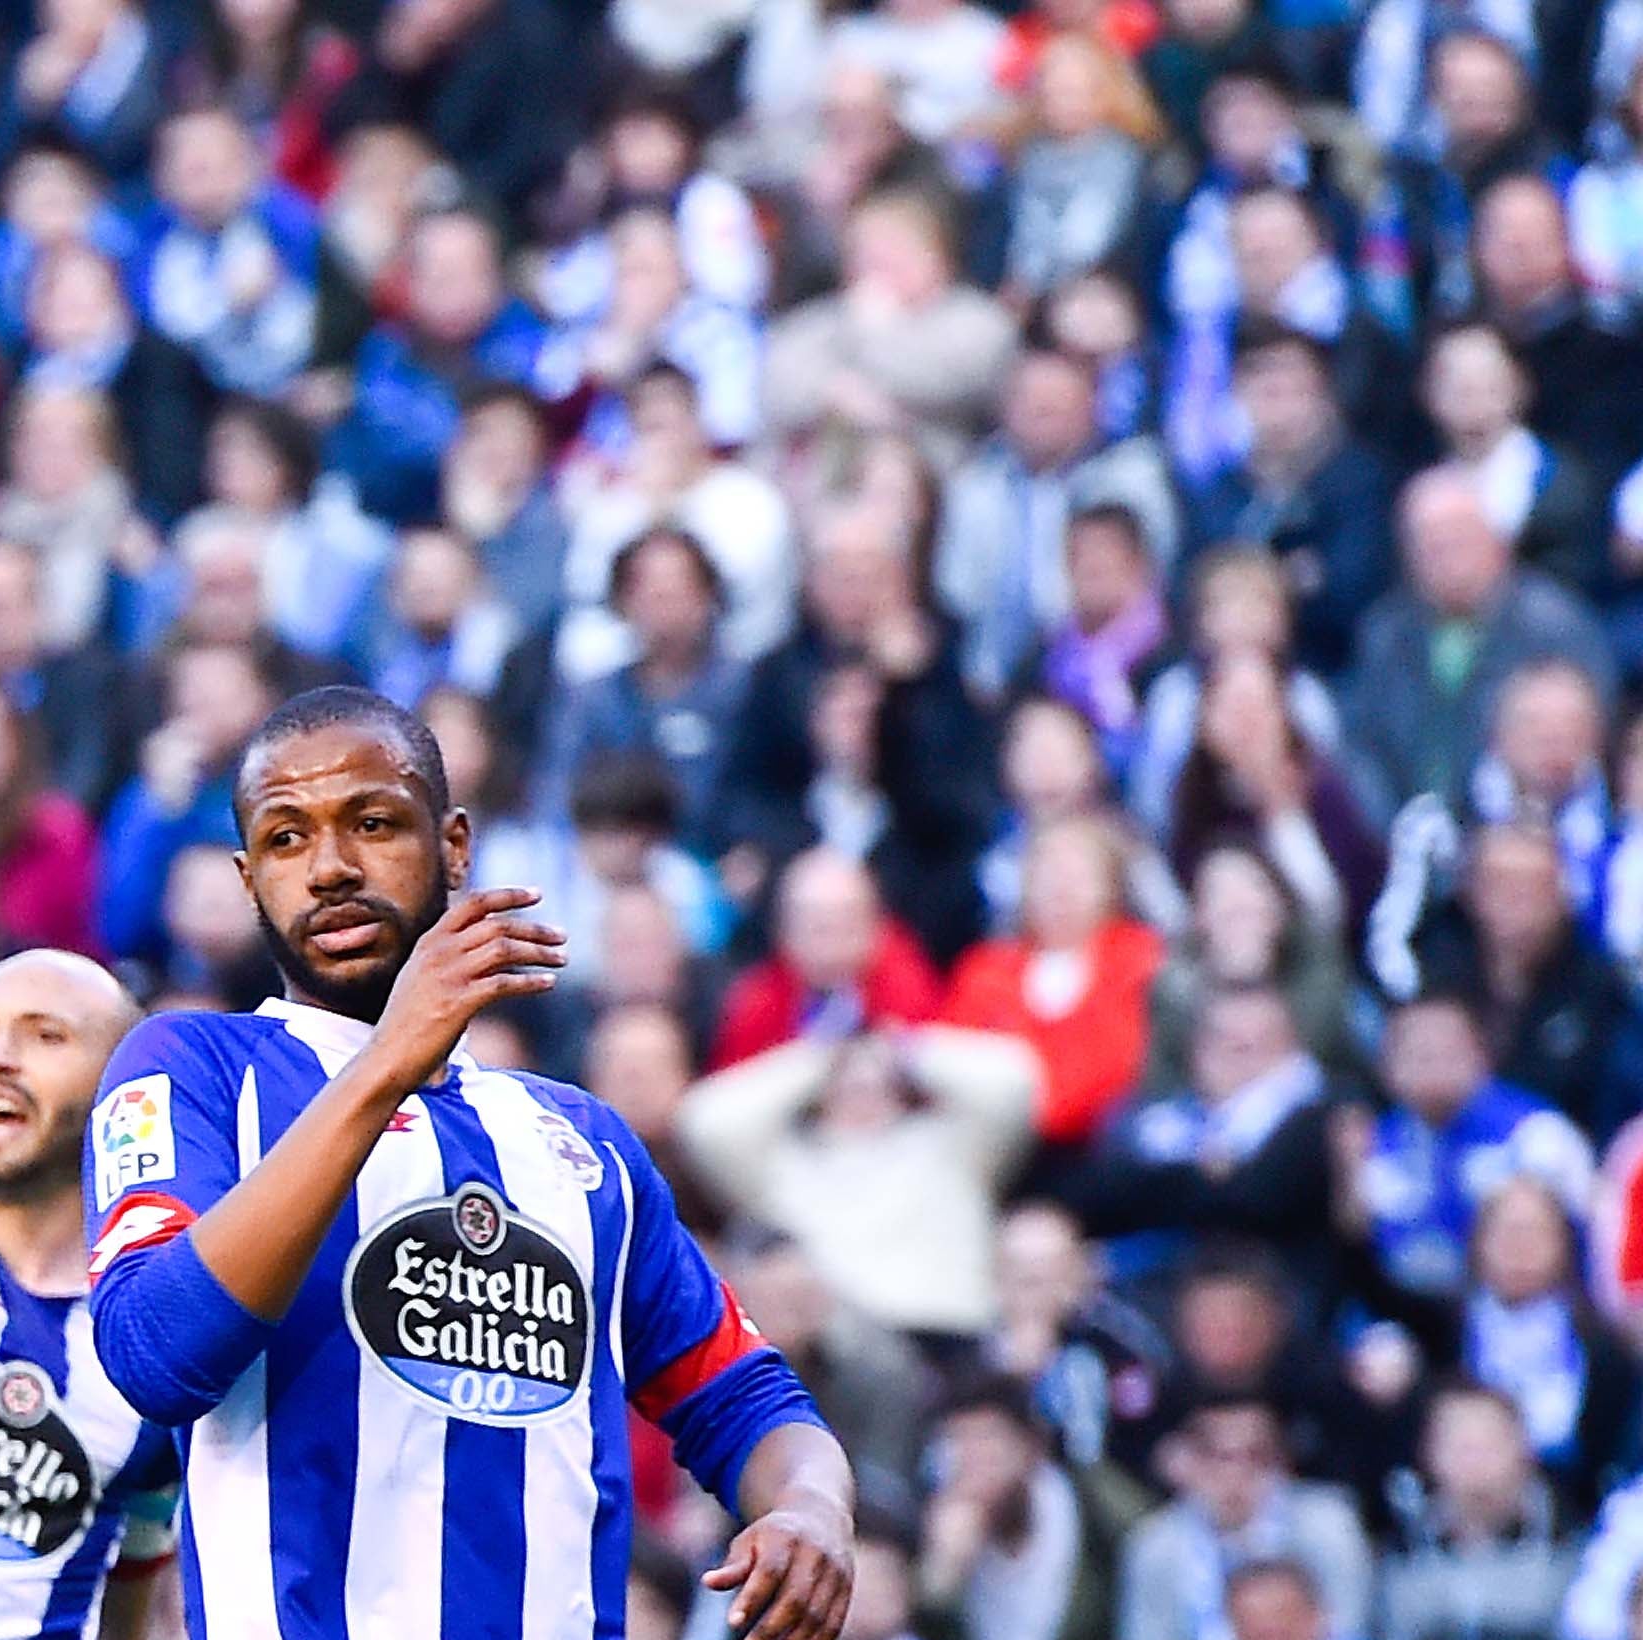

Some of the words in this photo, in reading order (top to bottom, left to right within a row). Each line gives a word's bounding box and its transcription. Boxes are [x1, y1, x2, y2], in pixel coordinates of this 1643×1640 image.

[106, 1152, 160, 1200] LFP
[388, 1237, 576, 1326] Estrella
[397, 1298, 567, 1382] Galicia
